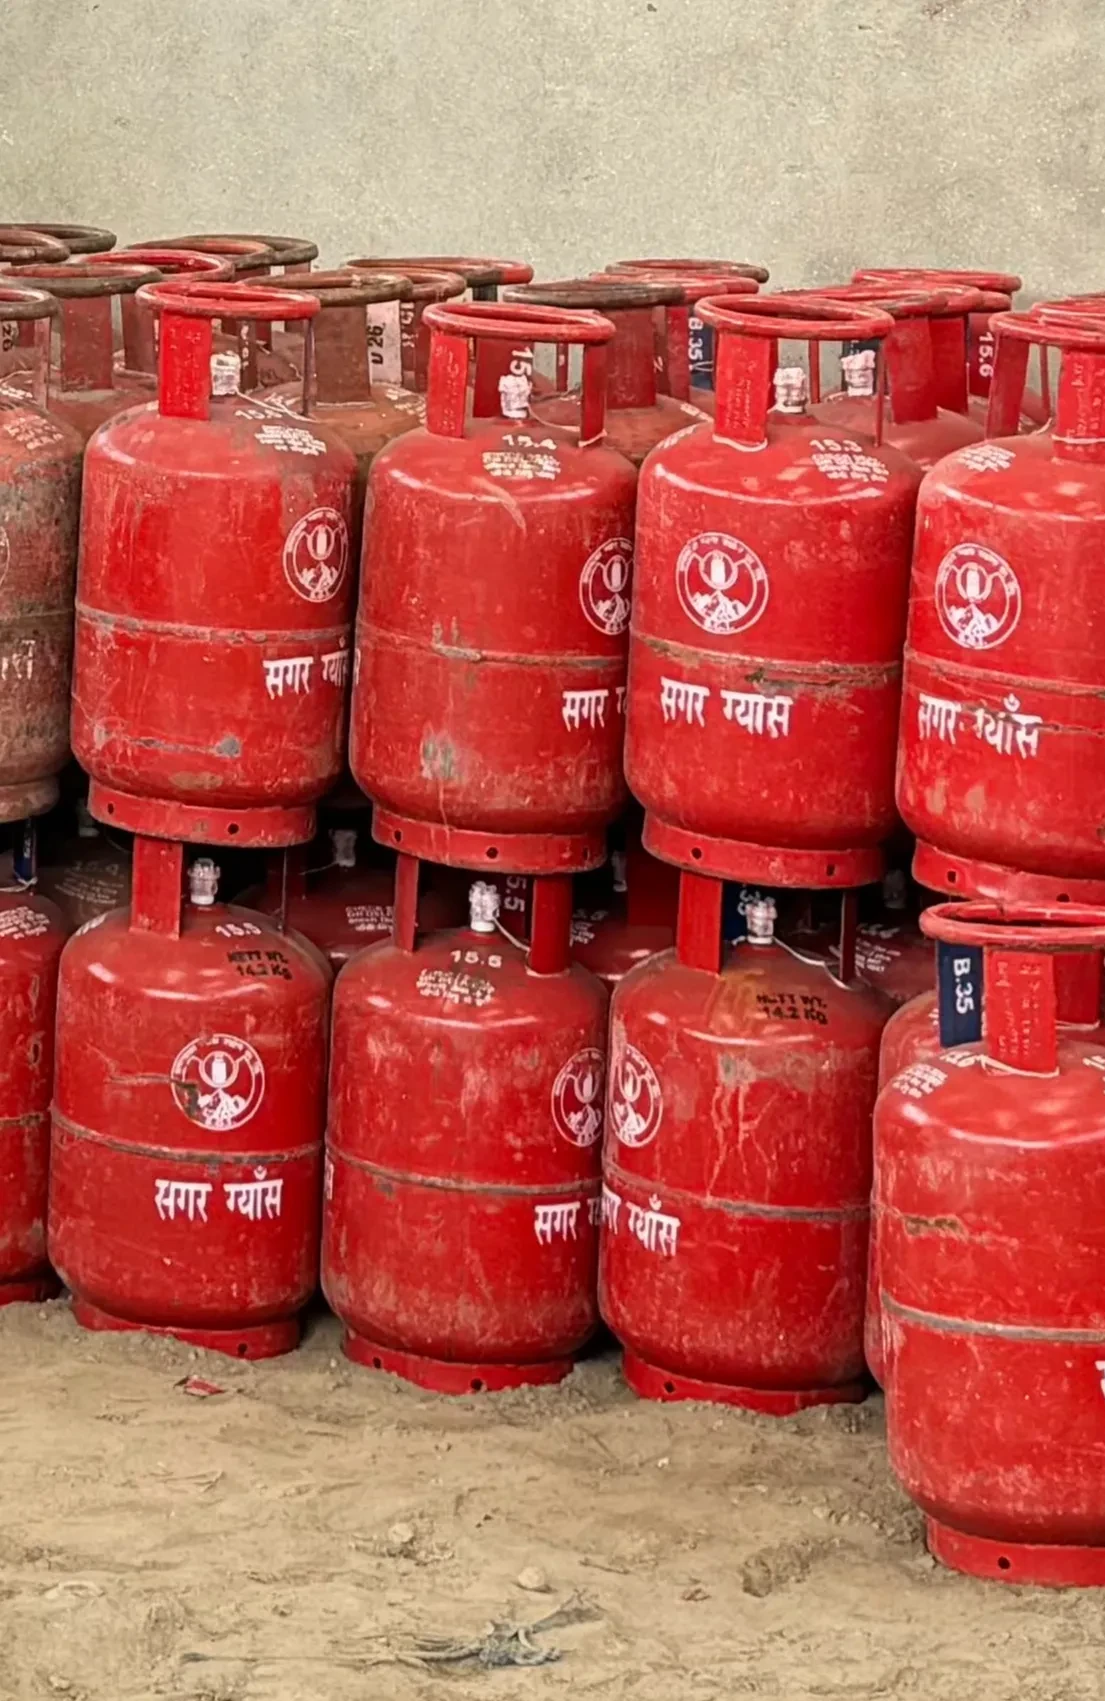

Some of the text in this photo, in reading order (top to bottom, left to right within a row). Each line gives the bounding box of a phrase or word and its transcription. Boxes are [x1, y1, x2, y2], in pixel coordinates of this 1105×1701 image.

[262, 655, 314, 700] सगर
[562, 689, 609, 732] सगर
[660, 676, 711, 728] सगर
[917, 692, 962, 745] सगर
[953, 957, 974, 1014] B.35
[154, 1178, 213, 1224] सगर
[534, 1200, 581, 1246] सगर
